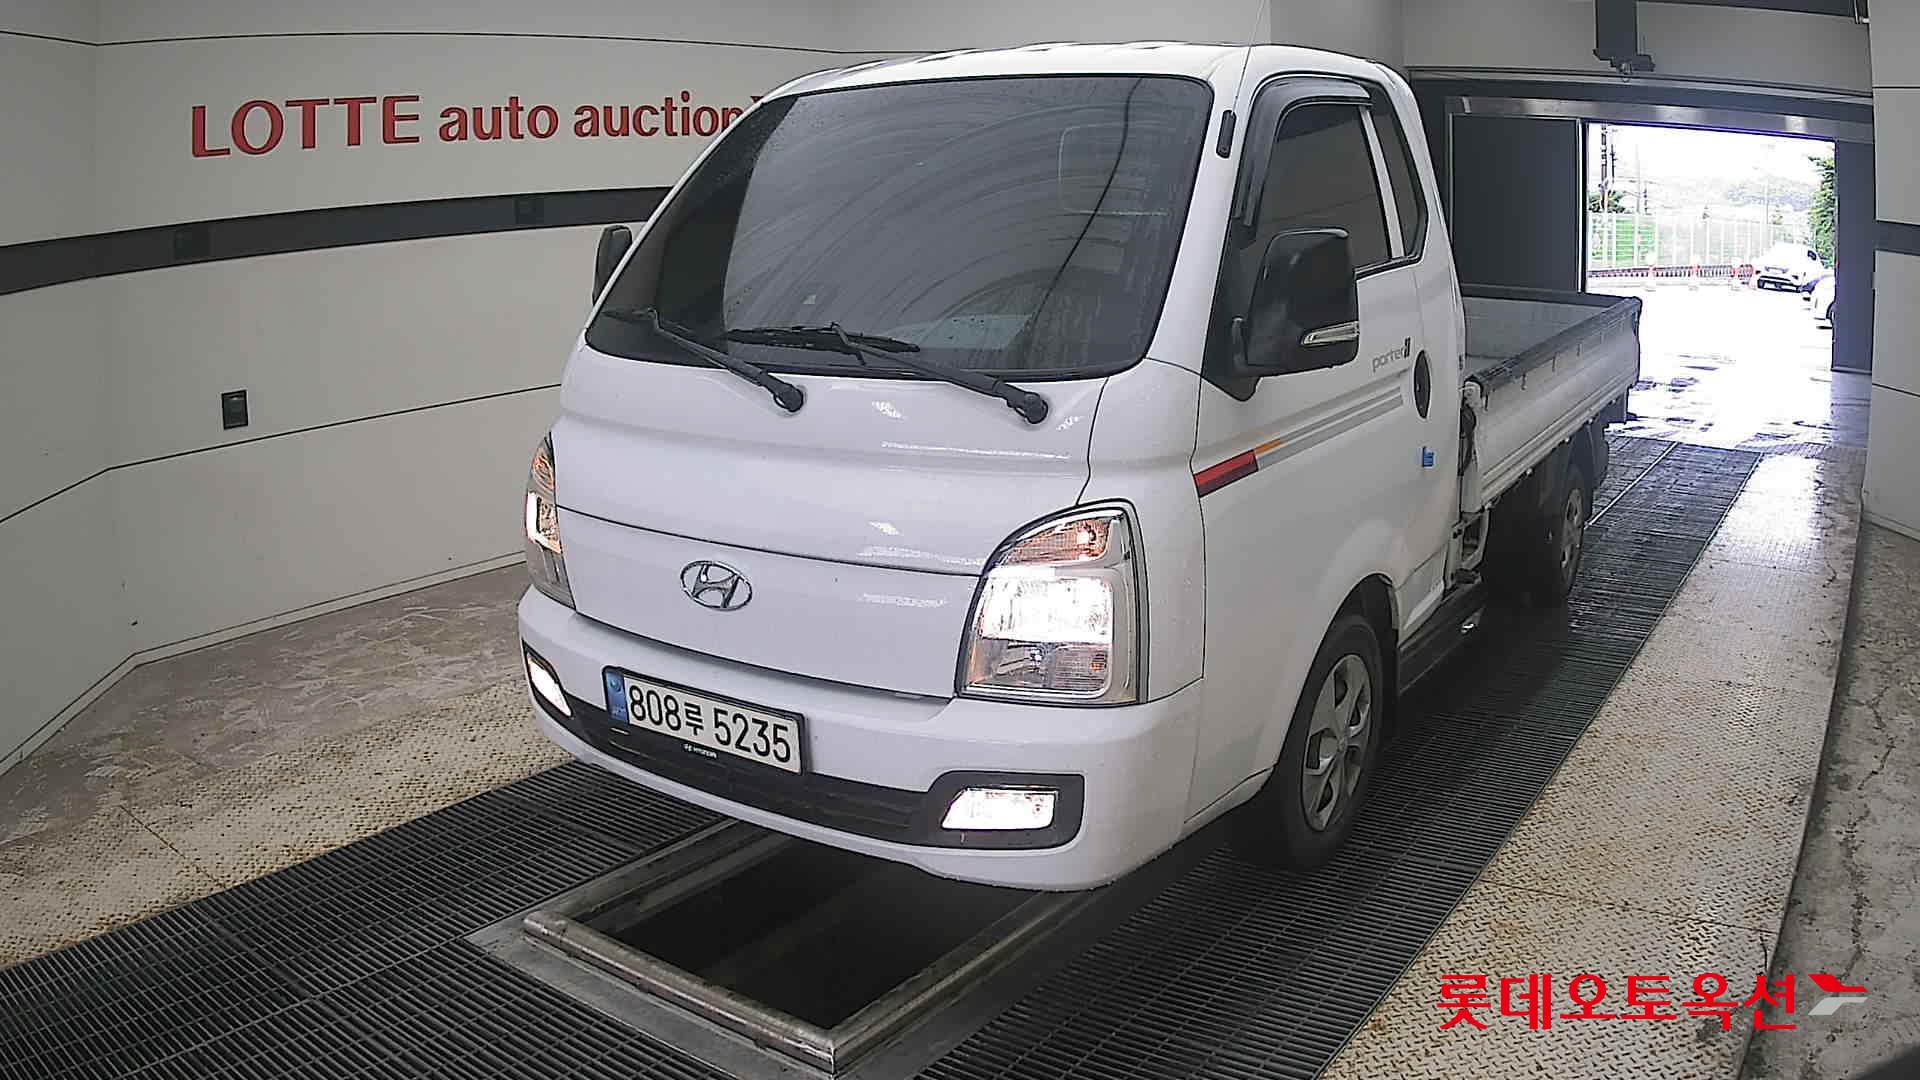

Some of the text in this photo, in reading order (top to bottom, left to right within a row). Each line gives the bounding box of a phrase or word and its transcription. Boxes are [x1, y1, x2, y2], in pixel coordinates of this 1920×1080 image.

[191, 94, 420, 158] LOTTE
[438, 96, 560, 143] auto
[628, 684, 792, 764] 808루 5235
